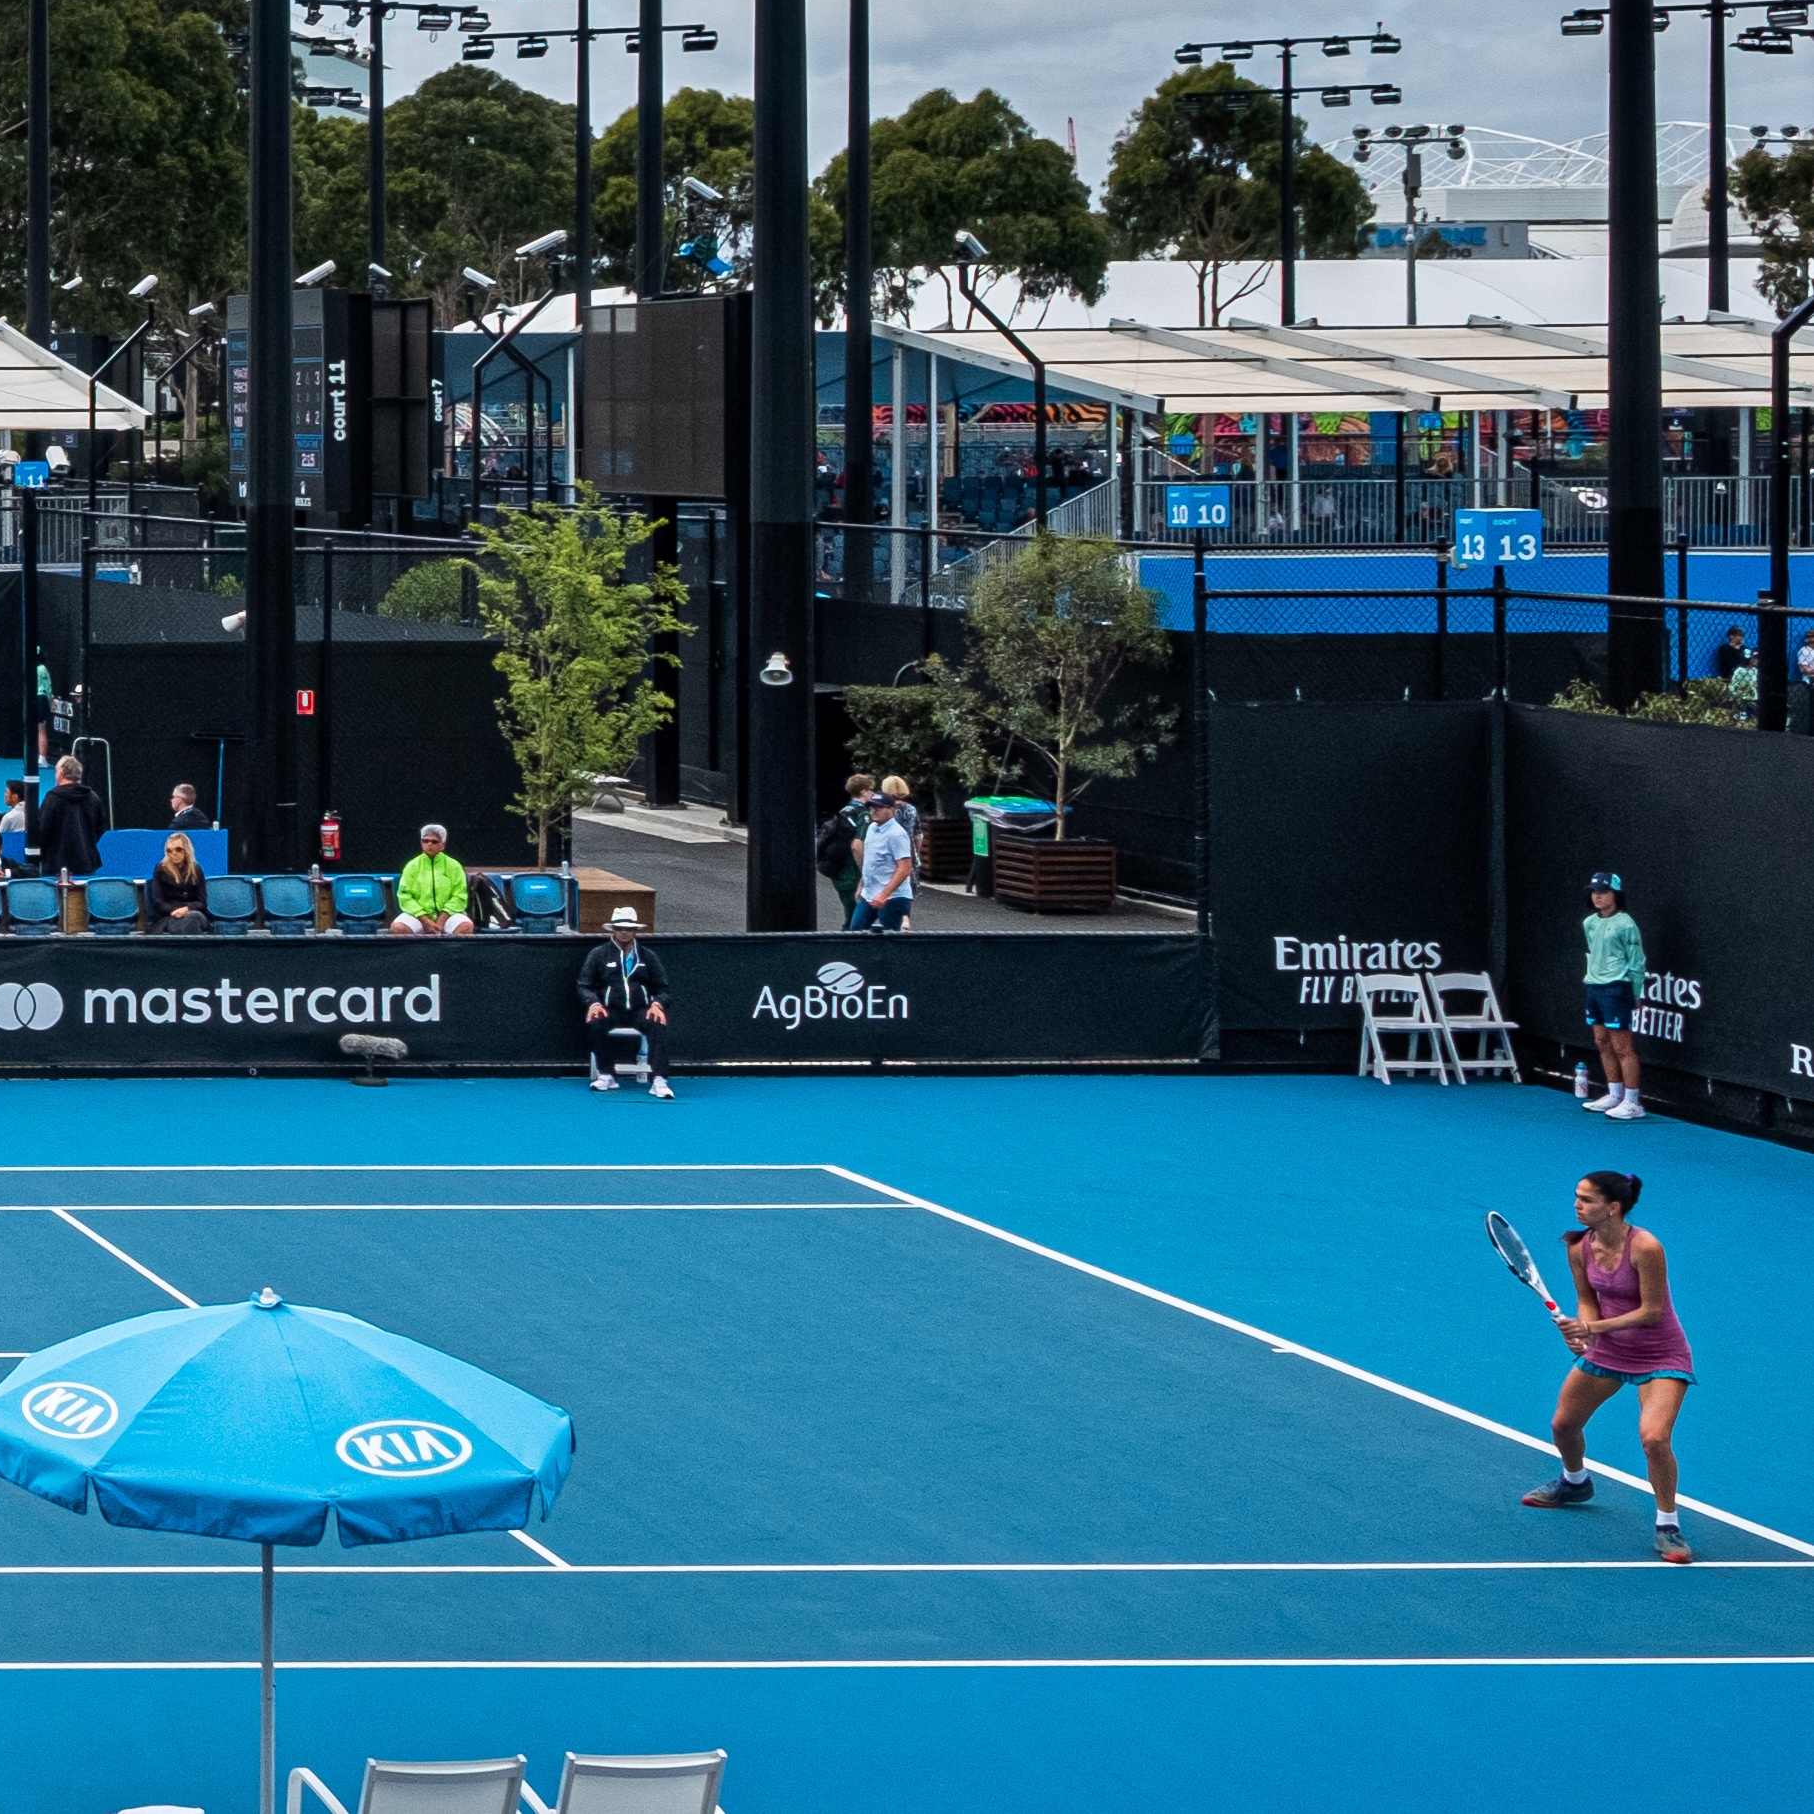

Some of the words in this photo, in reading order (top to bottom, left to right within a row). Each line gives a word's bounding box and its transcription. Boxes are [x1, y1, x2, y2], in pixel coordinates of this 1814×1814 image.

[328, 359, 347, 385] 11
[431, 378, 443, 388] 7
[329, 389, 347, 442] court
[431, 390, 443, 422] court
[1172, 504, 1189, 525] 10
[1197, 504, 1226, 525] 10
[1461, 534, 1485, 561] 13
[1498, 534, 1537, 562] 13
[1273, 934, 1442, 971] Emirates
[84, 973, 441, 1024] mastercard
[1299, 975, 1335, 1004] FLY
[1639, 970, 1702, 1010] rates
[752, 984, 908, 1030] AgBioEn
